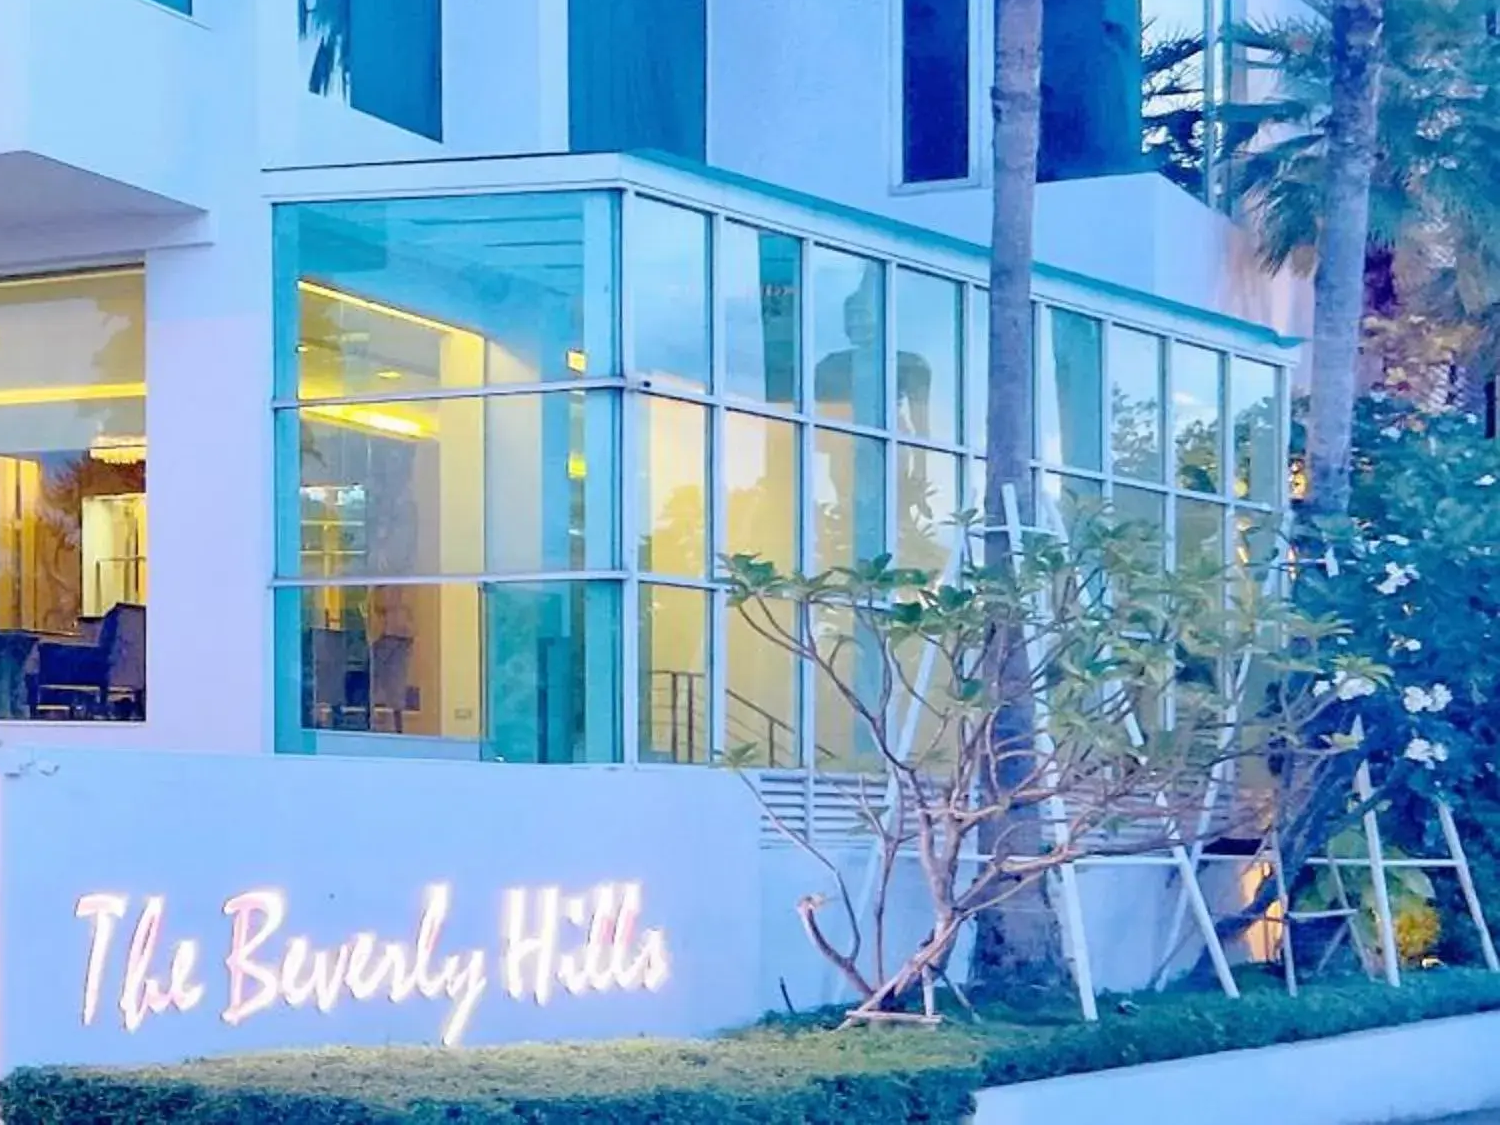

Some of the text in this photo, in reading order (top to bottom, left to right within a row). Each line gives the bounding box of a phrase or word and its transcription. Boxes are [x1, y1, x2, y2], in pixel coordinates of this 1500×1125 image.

[76, 881, 669, 1045] The Beverly Hills
